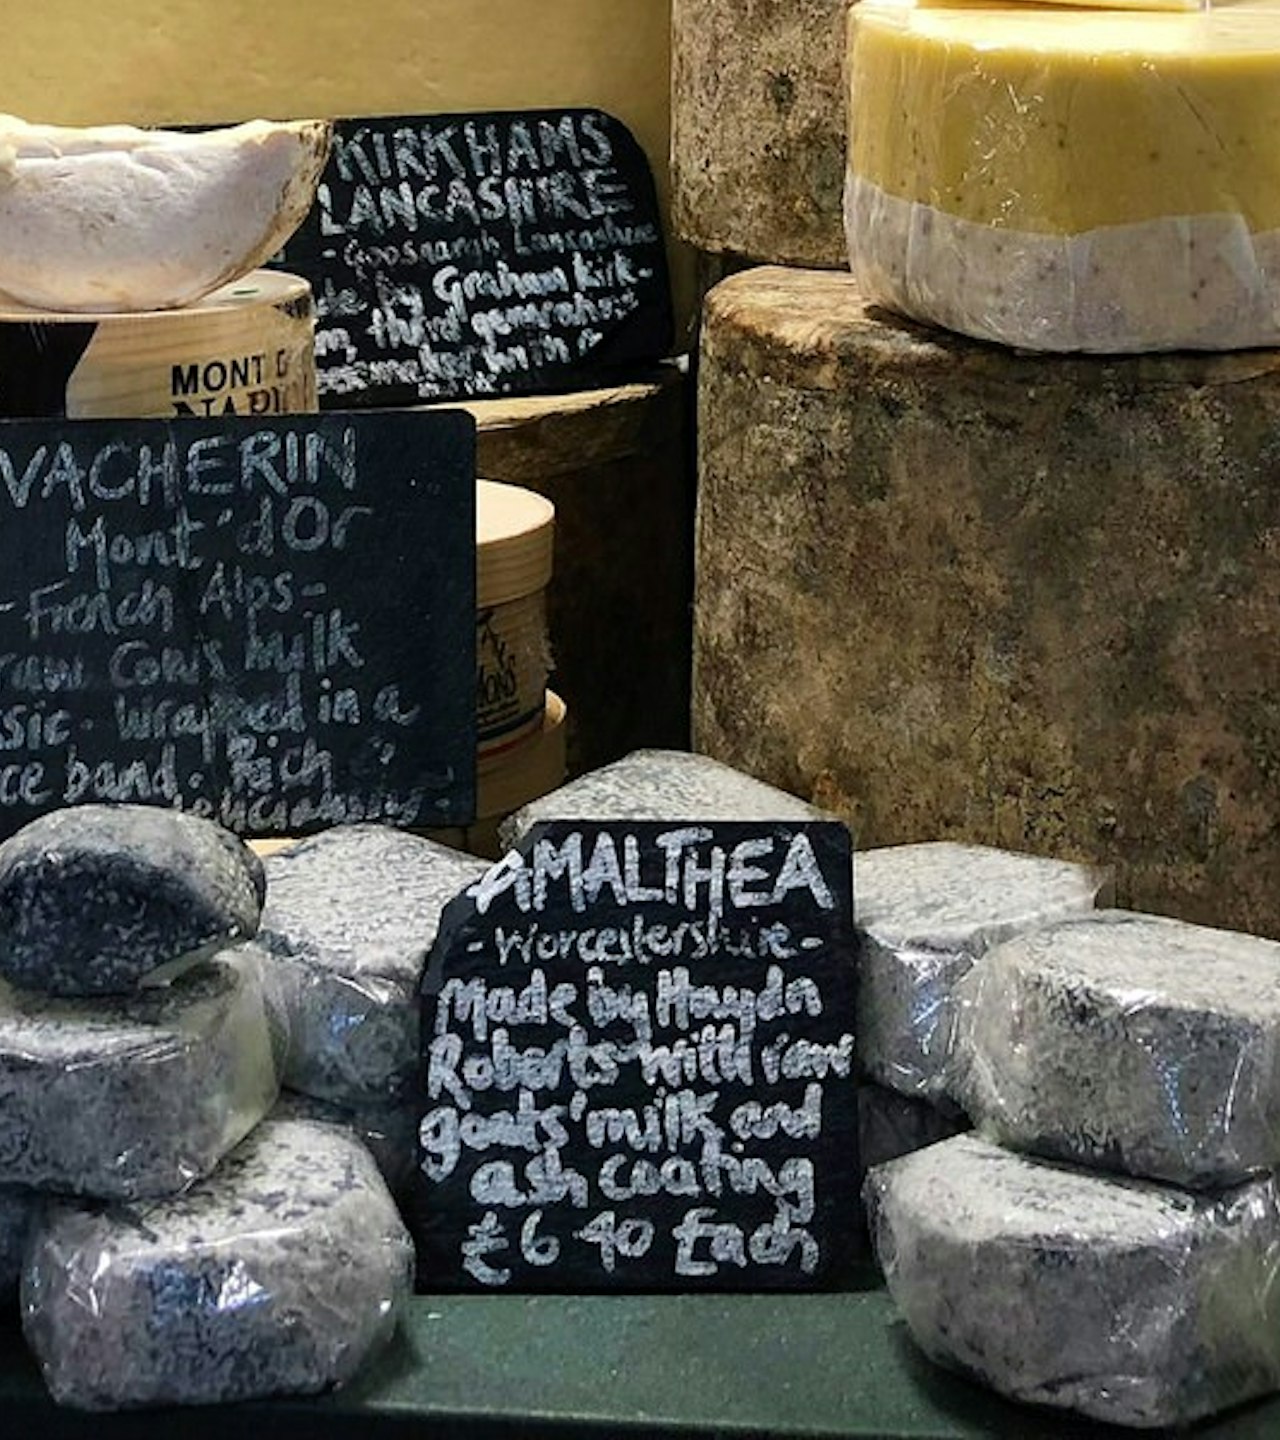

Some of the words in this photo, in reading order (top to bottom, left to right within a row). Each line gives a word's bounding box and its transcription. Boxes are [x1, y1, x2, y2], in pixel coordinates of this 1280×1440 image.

[332, 114, 614, 187] KIRKHAMS
[318, 167, 635, 237] LANCASHIRE
[172, 353, 267, 398] MONT
[66, 506, 206, 590] Mont
[320, 677, 361, 724] in
[467, 825, 837, 916] AMALTHEA
[435, 966, 580, 1042] Made
[587, 965, 652, 1040] by
[588, 1086, 725, 1152] milk
[730, 1082, 823, 1141] and
[469, 1148, 589, 1208] ash
